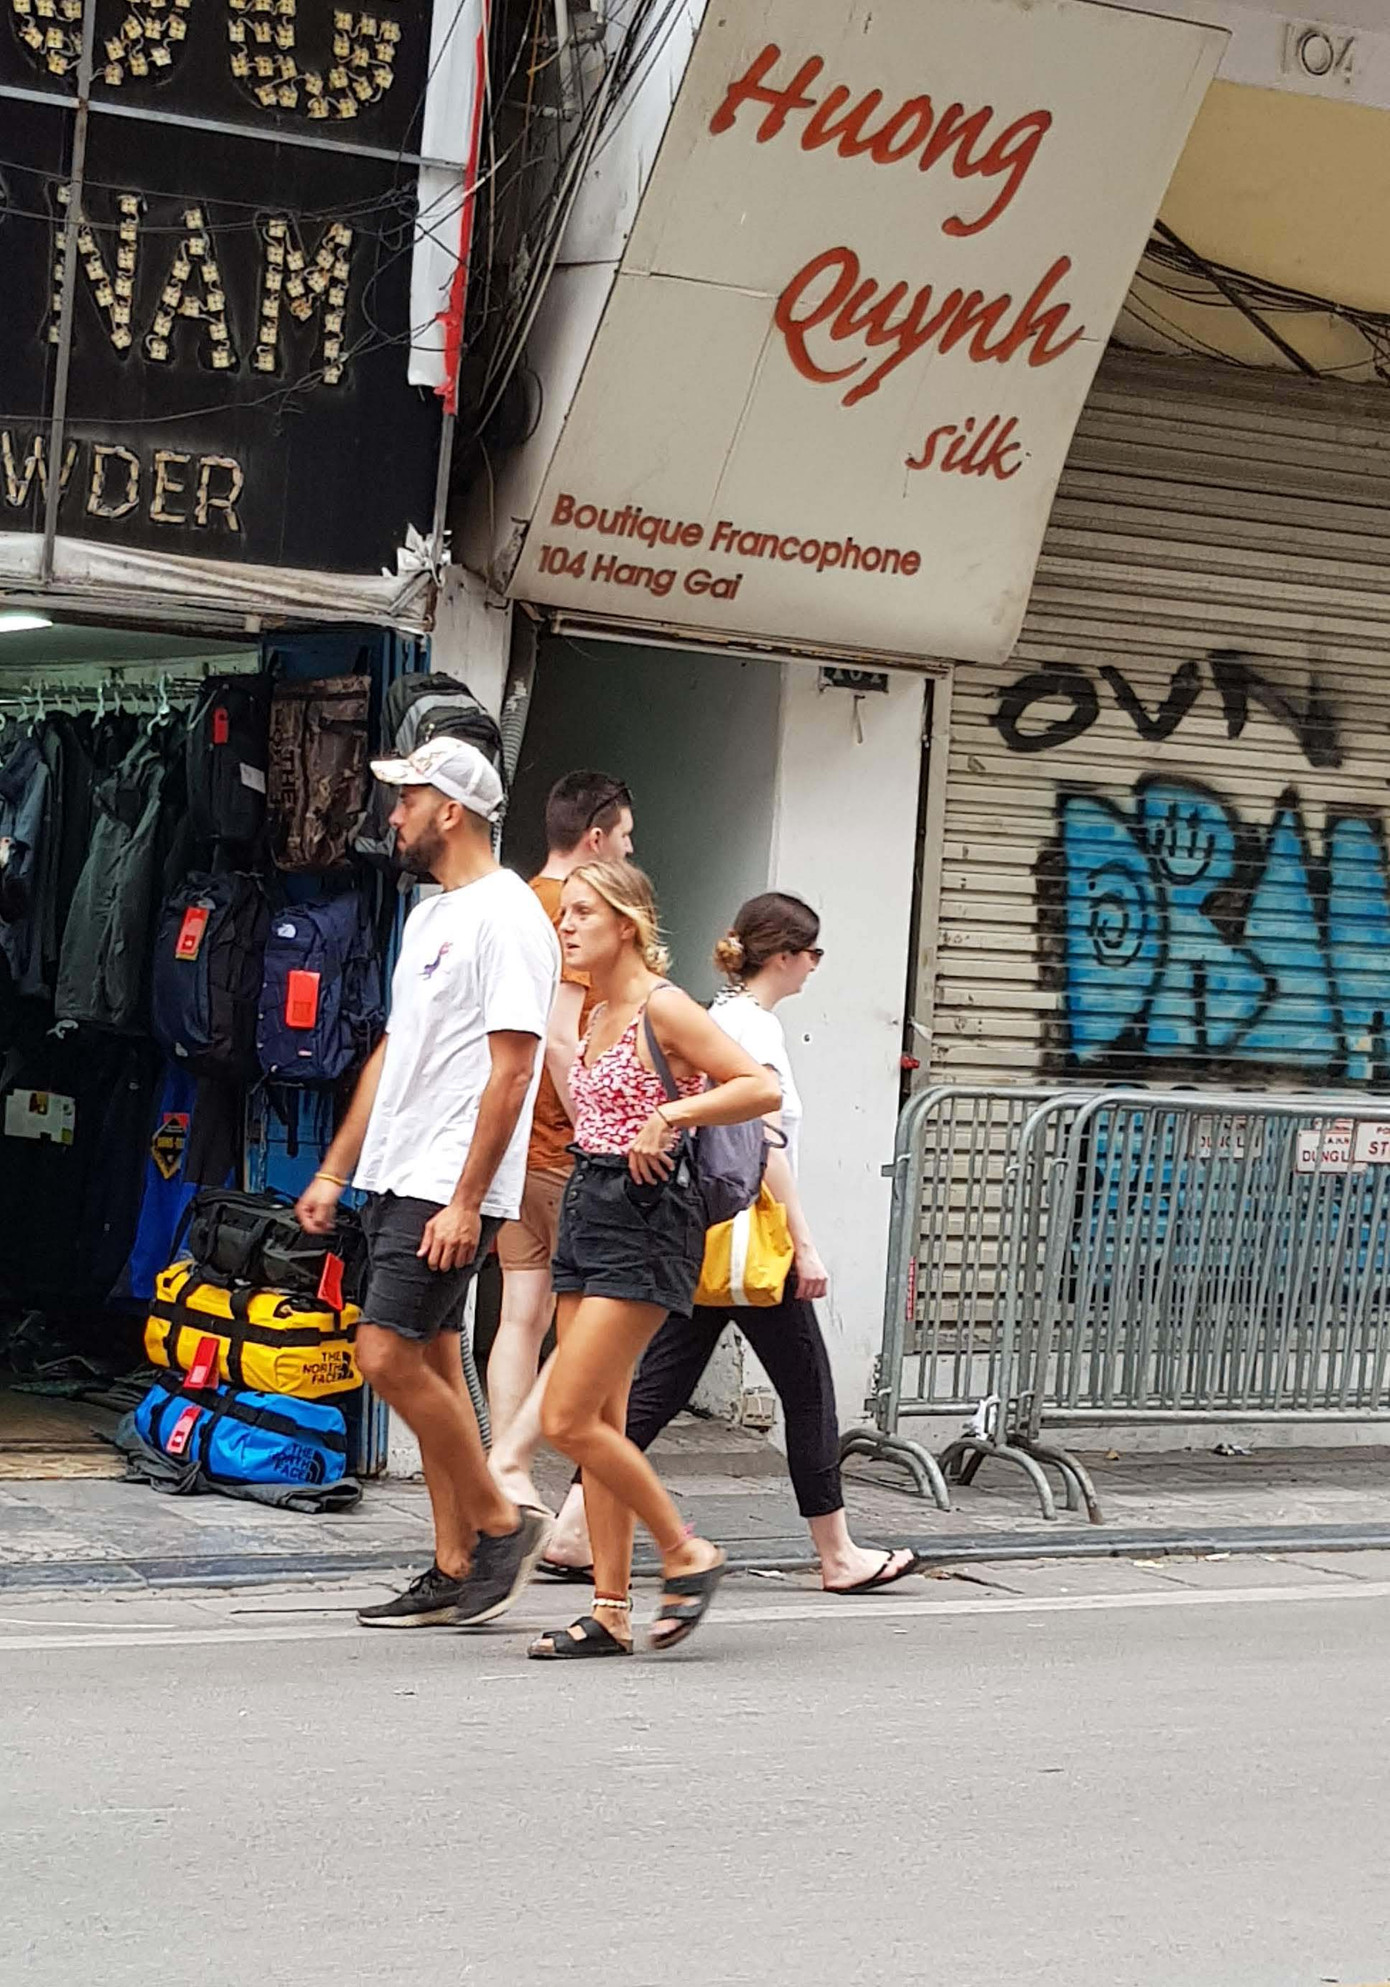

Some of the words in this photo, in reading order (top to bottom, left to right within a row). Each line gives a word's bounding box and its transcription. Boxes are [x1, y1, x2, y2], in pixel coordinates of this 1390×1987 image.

[707, 43, 1052, 238] Huong
[48, 183, 353, 385] NAM
[774, 246, 1085, 407] Quynh
[905, 415, 1022, 481] silk
[537, 545, 587, 578] 104
[591, 554, 677, 597] Hang
[683, 569, 743, 600] Gai
[551, 494, 704, 548] Boutique
[709, 520, 921, 577] Francophone
